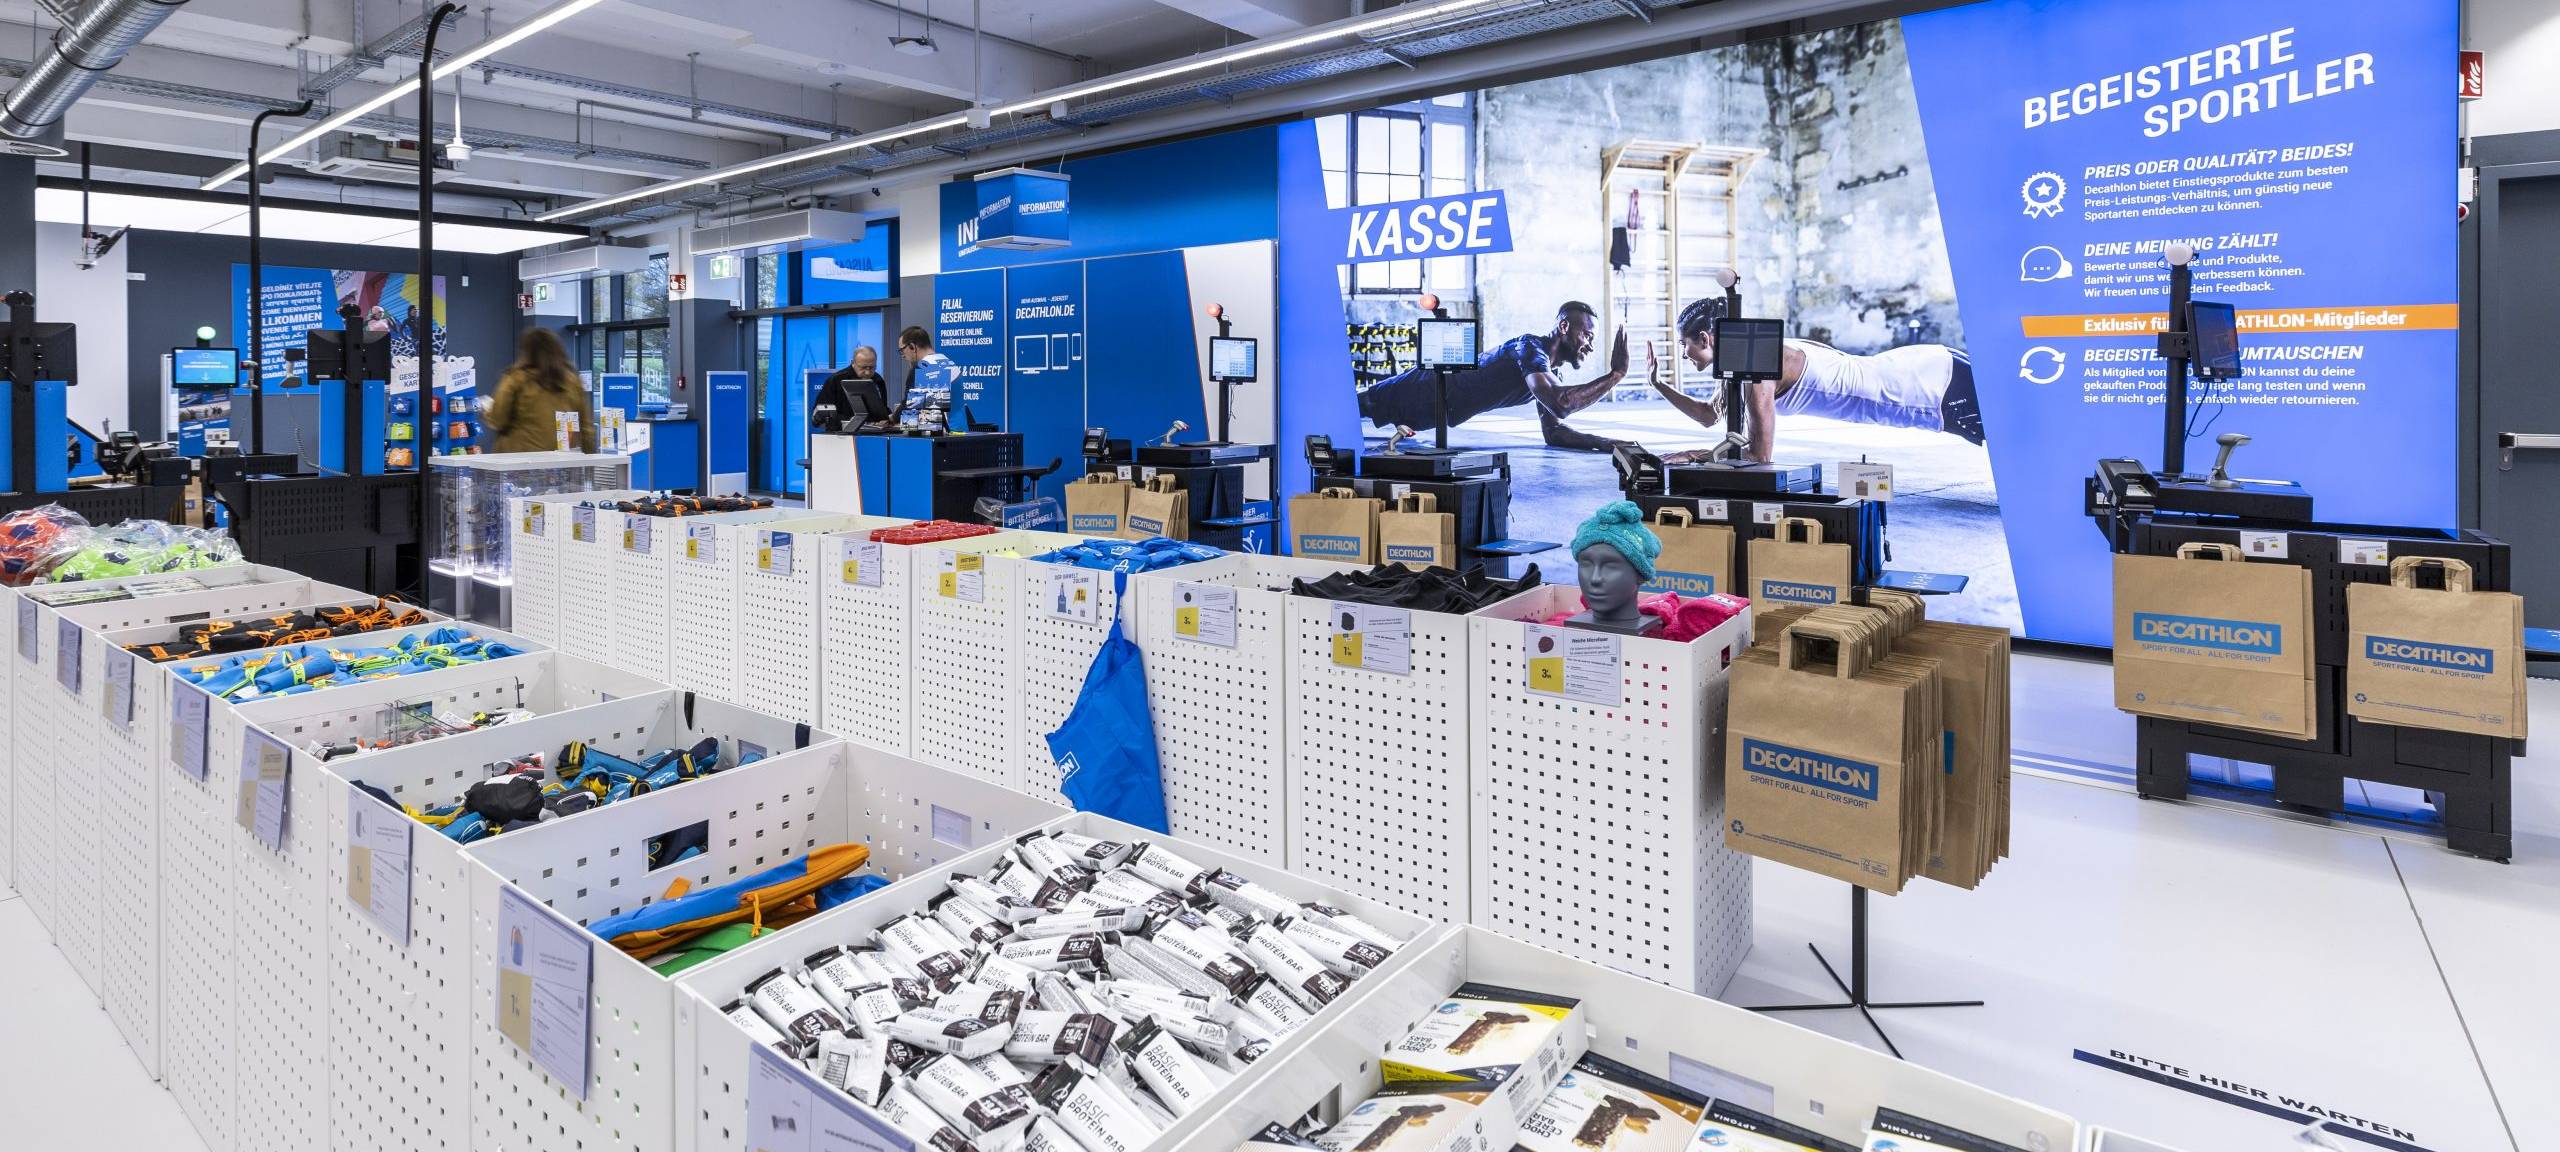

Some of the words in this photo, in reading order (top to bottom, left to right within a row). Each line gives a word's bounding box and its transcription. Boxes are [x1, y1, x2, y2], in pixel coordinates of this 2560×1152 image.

[2023, 27, 2297, 129] BEGEISTERTE
[2142, 51, 2375, 138] SPORTLER
[2084, 164, 2132, 180] PREIS
[2135, 160, 2179, 176] ODER
[2183, 149, 2277, 172] QUALITÄT?
[2281, 142, 2355, 164] BEIDES!
[2084, 181, 2137, 195] Decathlon
[2139, 178, 2171, 192] bietet
[2173, 171, 2275, 190] Einstiegsprodukte
[2277, 169, 2304, 179] zum
[2306, 164, 2349, 177] besten
[2084, 186, 2231, 208] Preis-Leistungs-Verhältnis,
[2233, 187, 2252, 197] um
[2255, 181, 2300, 197] günstig
[2302, 180, 2333, 191] neue
[979, 195, 1012, 219] INFORMATION
[1018, 200, 1066, 214] INFORMATION
[2084, 207, 2138, 222] Sportarten
[2141, 202, 2198, 218] entdecken
[2201, 203, 2214, 213] zu
[2217, 198, 2263, 212] können.
[1346, 196, 1500, 259] KASSE
[2084, 241, 2132, 257] DEINE
[2135, 237, 2214, 255] MEING
[2217, 232, 2279, 250] ZÄHLT!
[2084, 259, 2127, 272] Bewerte
[2128, 258, 2164, 270] unsere
[2202, 254, 2225, 267] und
[2227, 251, 2283, 266] Produkte,
[2084, 272, 2114, 285] damit
[2116, 272, 2133, 284] wir
[2135, 274, 2155, 283] uns
[2193, 266, 2256, 280] verbessern
[2257, 264, 2306, 277] können.
[2084, 287, 2102, 298] Wir
[2104, 285, 2137, 297] freuen
[2139, 286, 2160, 296] uns
[2191, 281, 2213, 294] dein
[2215, 280, 2275, 293] Feedback.
[941, 299, 963, 310] FILIAL
[1015, 304, 1075, 320] DECATHLON.DE
[940, 309, 994, 323] RESERVIERUNG
[2084, 317, 2147, 333] Exklusiv
[2235, 311, 2408, 332] ATHLON-Mitglieder
[940, 328, 965, 337] PRODUKTE
[965, 327, 983, 336] ONLINE
[940, 338, 974, 347] ZURÜCKLEGEN
[974, 337, 993, 346] LASSEN
[2084, 348, 2168, 362] BEGEISTE
[2237, 345, 2364, 361] UMTAUSCHEN
[962, 367, 970, 377] &
[970, 365, 1002, 377] COLLECT
[2084, 366, 2100, 377] Als
[2102, 366, 2154, 379] Mitglied
[2156, 368, 2168, 377] von
[2259, 365, 2300, 377] kannst
[2302, 365, 2317, 377] du
[2319, 365, 2356, 377] deine
[2084, 379, 2135, 392] gekauften
[2237, 379, 2261, 393] lang
[2264, 380, 2303, 391] testen
[2305, 379, 2329, 391] und
[2331, 381, 2366, 391] wenn
[2084, 394, 2099, 404] sie
[2100, 393, 2115, 404] dir
[2117, 392, 2143, 404] nicht
[2195, 392, 2237, 405] einfach
[2239, 393, 2278, 405] wieder
[2281, 394, 2360, 405] retournieren.
[1008, 513, 1025, 526] BITTE
[1025, 508, 1039, 520] HIER
[1073, 517, 1115, 530] DECATHLON
[1130, 517, 1162, 533] DECATHLON
[1303, 538, 1358, 552] DECATHLON
[1389, 548, 1432, 559] DECATHLON
[1766, 584, 1832, 601] DECATHLON
[2141, 618, 2273, 648] DECATHLON
[2141, 643, 2168, 652] SPORT
[2169, 646, 2185, 655] FOR
[2186, 648, 2201, 657] ALL
[2208, 650, 2224, 659] ALL
[2225, 651, 2242, 660] FOR
[2243, 653, 2272, 664] SPORT
[2372, 641, 2486, 668] DECATHLON
[2373, 661, 2396, 669] SPORT
[2397, 663, 2411, 672] FOR
[2412, 665, 2425, 674] ALL
[2430, 667, 2444, 676] ALL
[2445, 669, 2460, 678] FOR
[2461, 671, 2485, 680] SPORT
[1750, 747, 1870, 792] DECATHLON
[1750, 775, 1774, 787] SPORT
[1775, 780, 1790, 791] FOR
[1791, 783, 1805, 794] ALL
[1810, 788, 1825, 799] ALL
[1826, 791, 1842, 803] FOR
[1842, 796, 1869, 810] SPORT
[1142, 856, 1170, 873] PROTEIN
[1170, 868, 1185, 879] BAR
[1000, 879, 1021, 897] PROTEIN
[944, 902, 964, 919] PROTEIN
[962, 914, 974, 926] BAR
[1002, 950, 1033, 960] PROTEIN
[1034, 948, 1052, 957] BAR
[1157, 932, 1187, 951] PROTEIN
[1186, 947, 1204, 961] BAR
[1255, 935, 1286, 959] PROTEIN
[1285, 955, 1303, 973] BAR
[980, 976, 1011, 992] PROTEIN
[762, 985, 786, 1007] PROTEIN
[780, 999, 797, 1015] BAR
[1255, 995, 1289, 1024] PROTEIN
[1262, 989, 1291, 1013] BASIC
[1034, 1033, 1050, 1043] BAR
[1152, 1044, 1181, 1072] BASIC
[926, 1068, 955, 1091] PROTEIN
[950, 1083, 969, 1099] BAR
[1144, 1050, 1176, 1087] PROTEIN
[1171, 1082, 1190, 1101] BAR
[2110, 1049, 2190, 1078] BITTE
[2200, 1073, 2270, 1101] HIER
[2278, 1095, 2416, 1142] WARTEN
[1075, 1092, 1110, 1124] BASIC
[1066, 1101, 1106, 1138] PROTEIN
[1104, 1135, 1127, 1152] BAR
[1713, 1112, 1757, 1131] APTONIA
[1880, 1122, 1932, 1142] APTONIA
